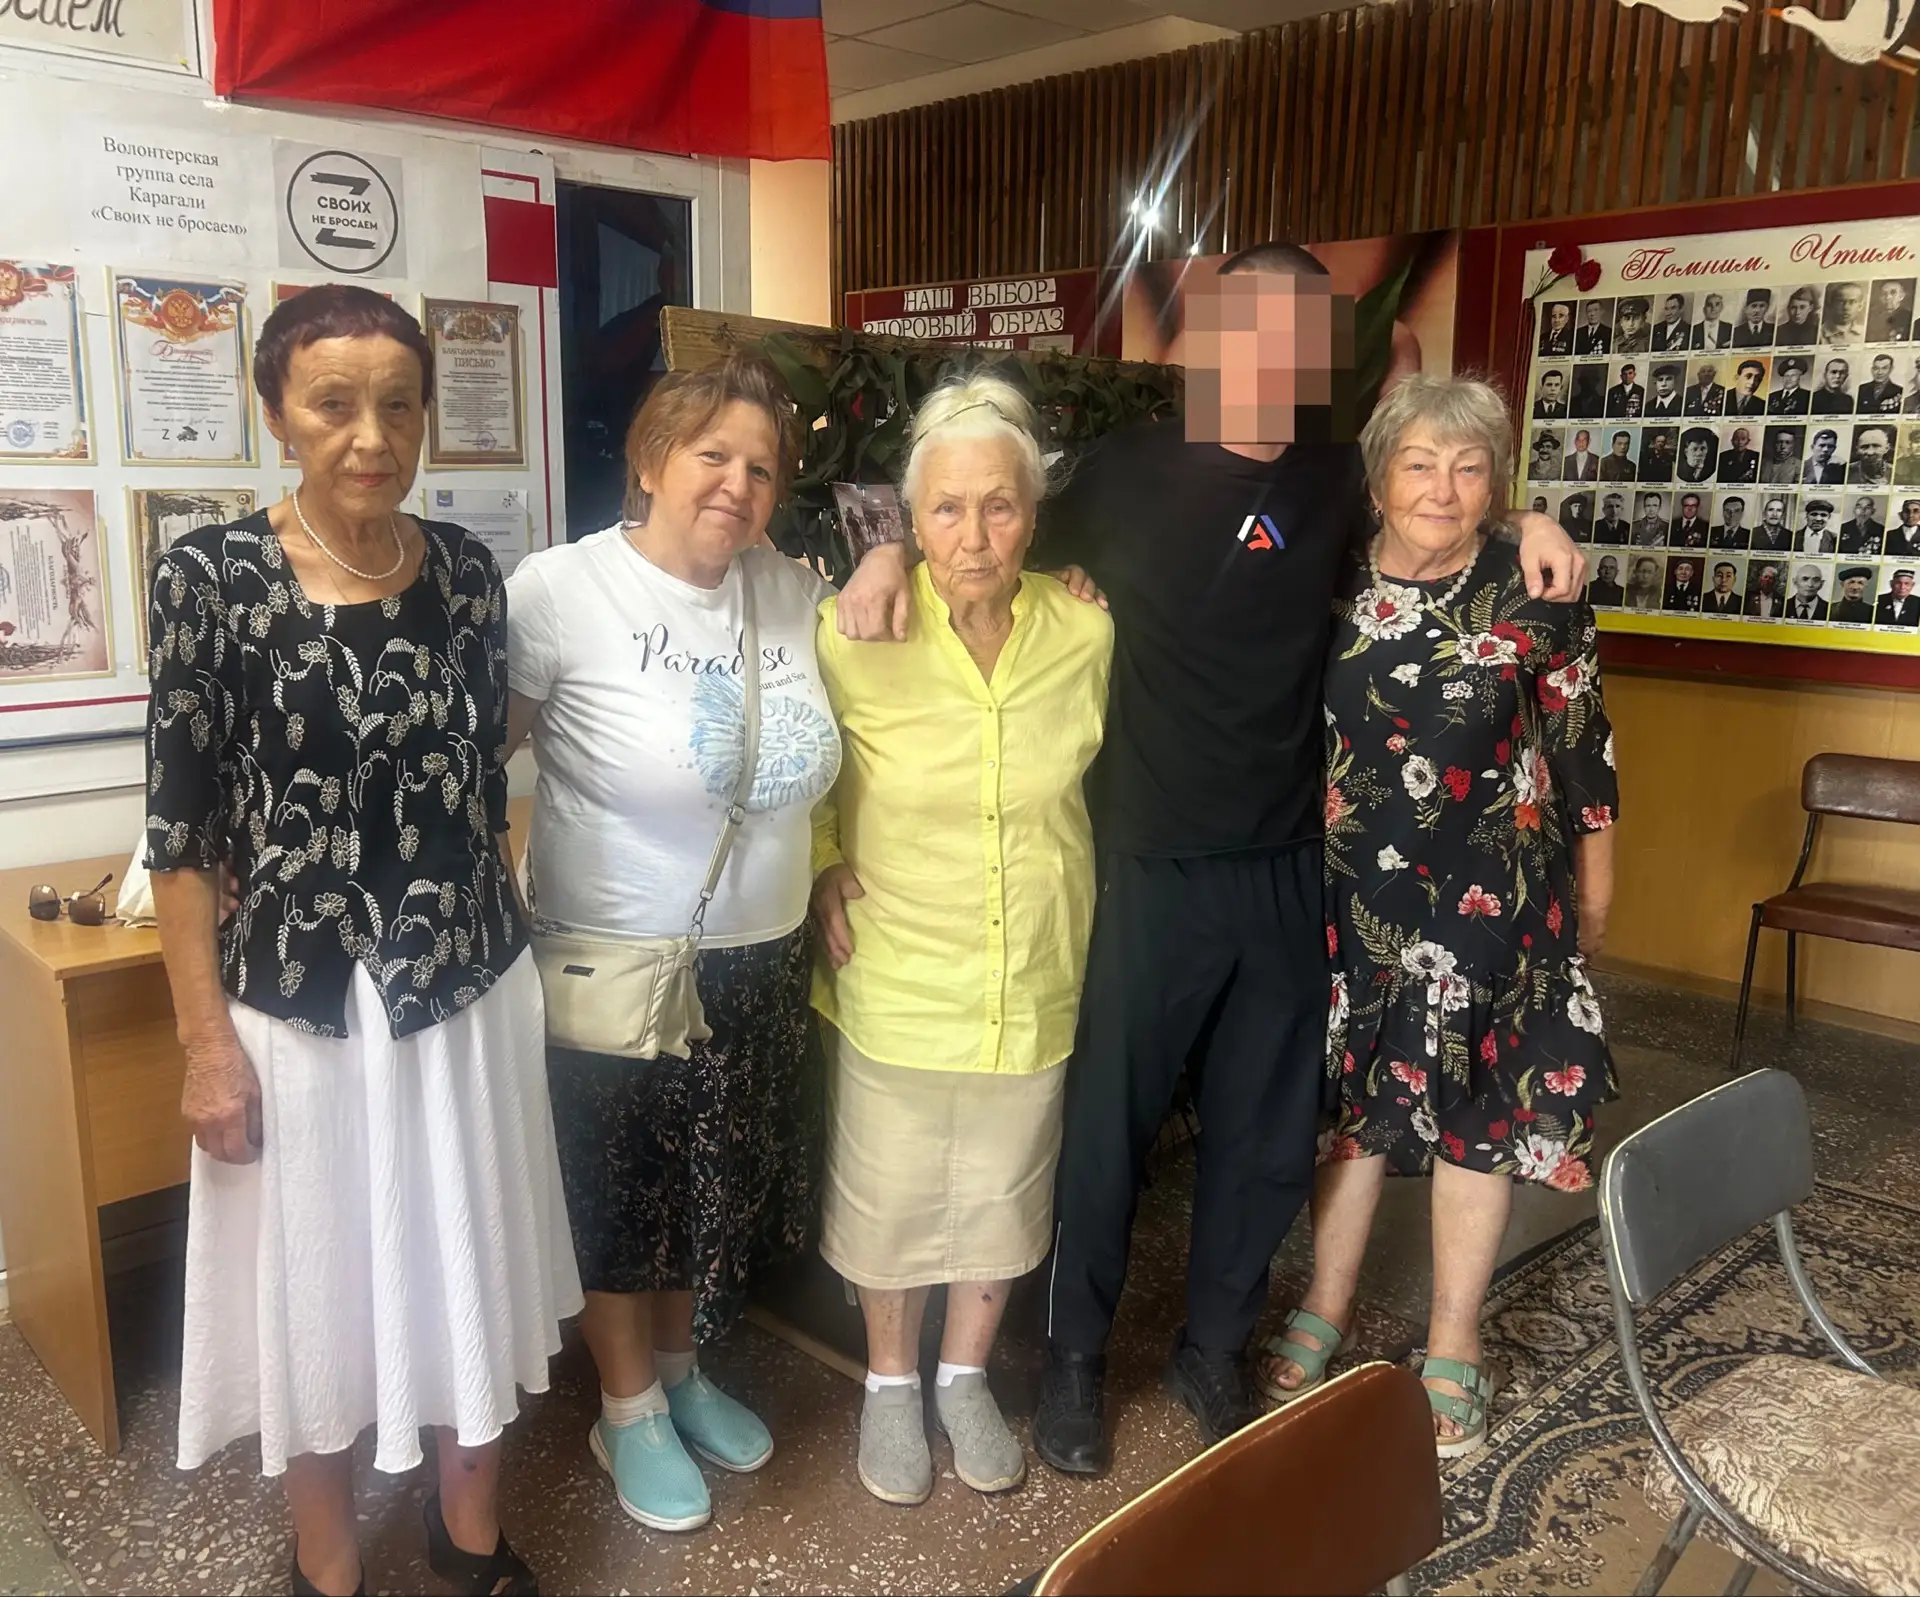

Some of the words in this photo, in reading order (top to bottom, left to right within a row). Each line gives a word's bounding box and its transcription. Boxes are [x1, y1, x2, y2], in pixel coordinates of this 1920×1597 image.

[102, 136, 219, 166] Волонтерская
[116, 165, 174, 183] группа
[179, 173, 214, 188] села
[129, 186, 206, 210] Карагали
[317, 196, 371, 214] СВОИХ
[91, 205, 151, 225] «Своих
[156, 215, 174, 228] не
[177, 214, 247, 235] бросаем»
[312, 214, 326, 225] НЕ
[328, 215, 378, 230] БРОСАЕМ
[1620, 247, 1771, 281] Помним.
[1789, 233, 1916, 270] Чтим.
[904, 289, 952, 311] НАШ
[969, 280, 1056, 307] ВЫБОР-
[990, 308, 1064, 335] ОБРАЗ
[454, 357, 496, 369] ПИСЬМО
[161, 428, 170, 440] Z
[207, 429, 217, 441] V
[632, 623, 793, 676] Paradse
[775, 674, 793, 687] and
[790, 672, 807, 682] Sea
